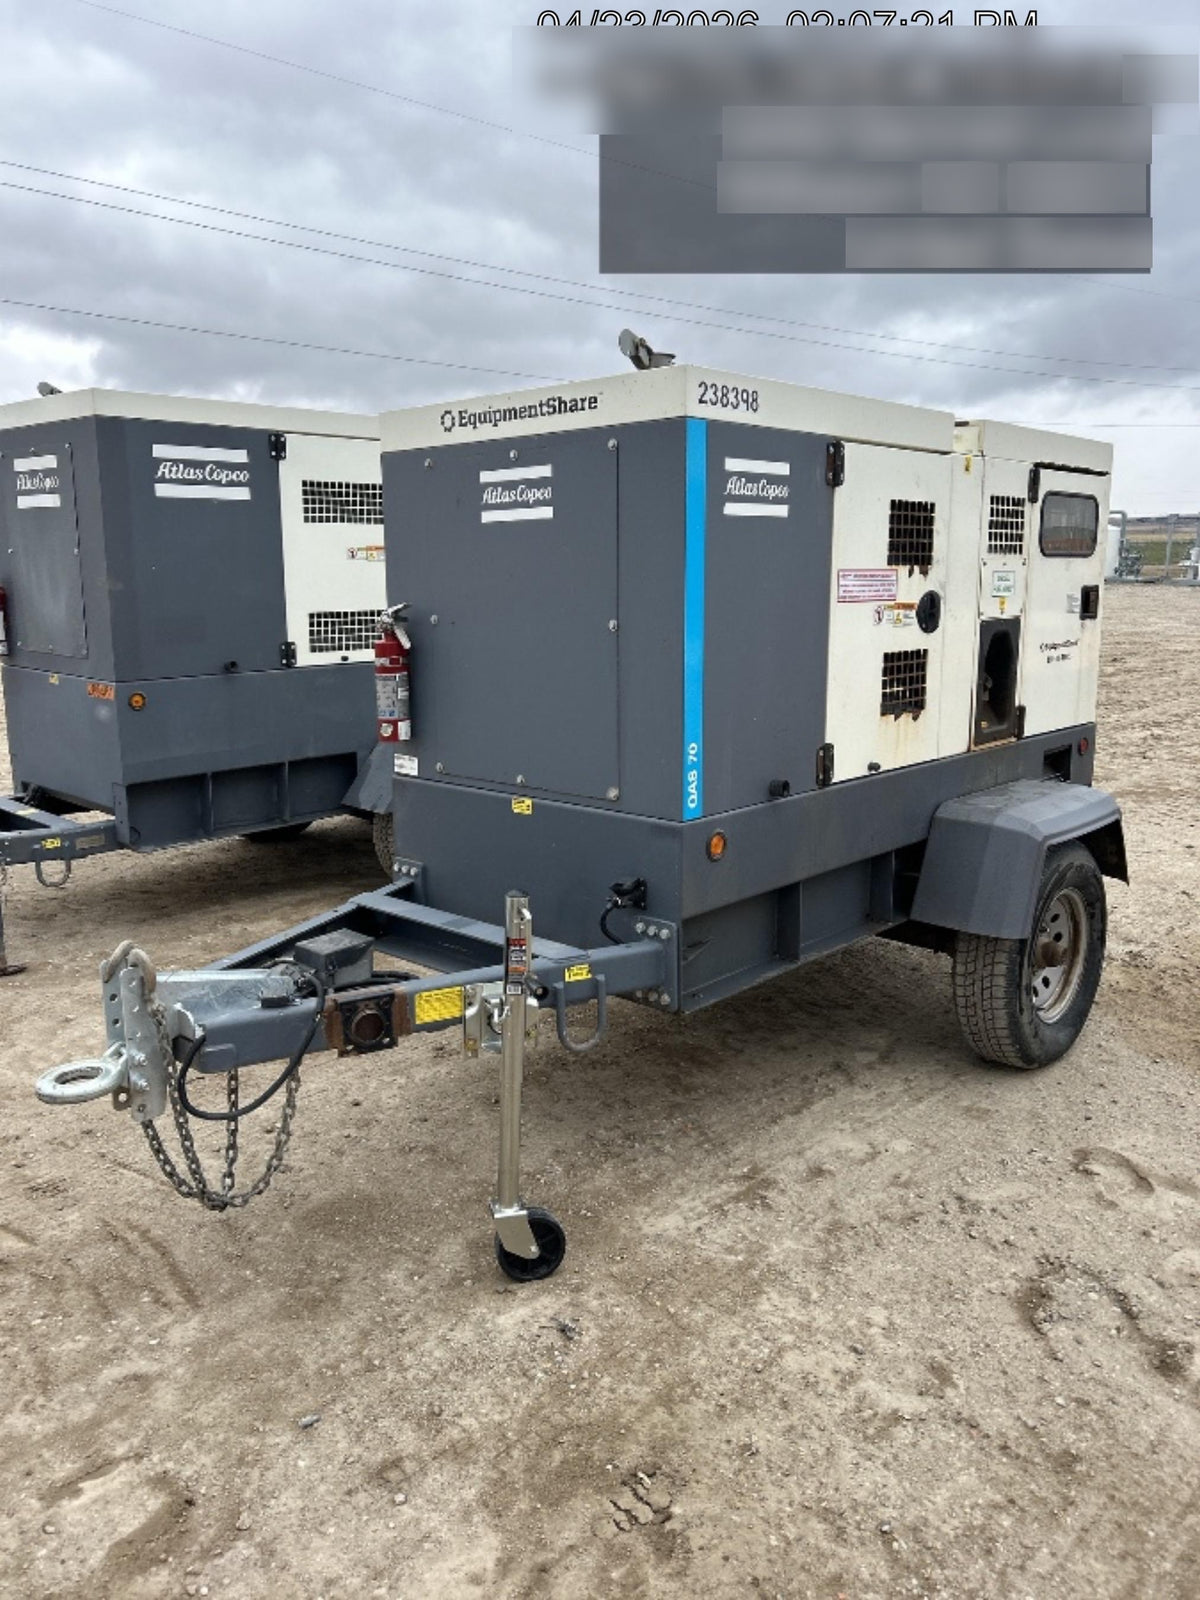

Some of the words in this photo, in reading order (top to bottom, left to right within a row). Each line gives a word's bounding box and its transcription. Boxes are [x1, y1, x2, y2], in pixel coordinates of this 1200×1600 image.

[458, 395, 598, 429] EquipmentShare
[698, 381, 759, 413] 238398
[687, 742, 698, 765] 70
